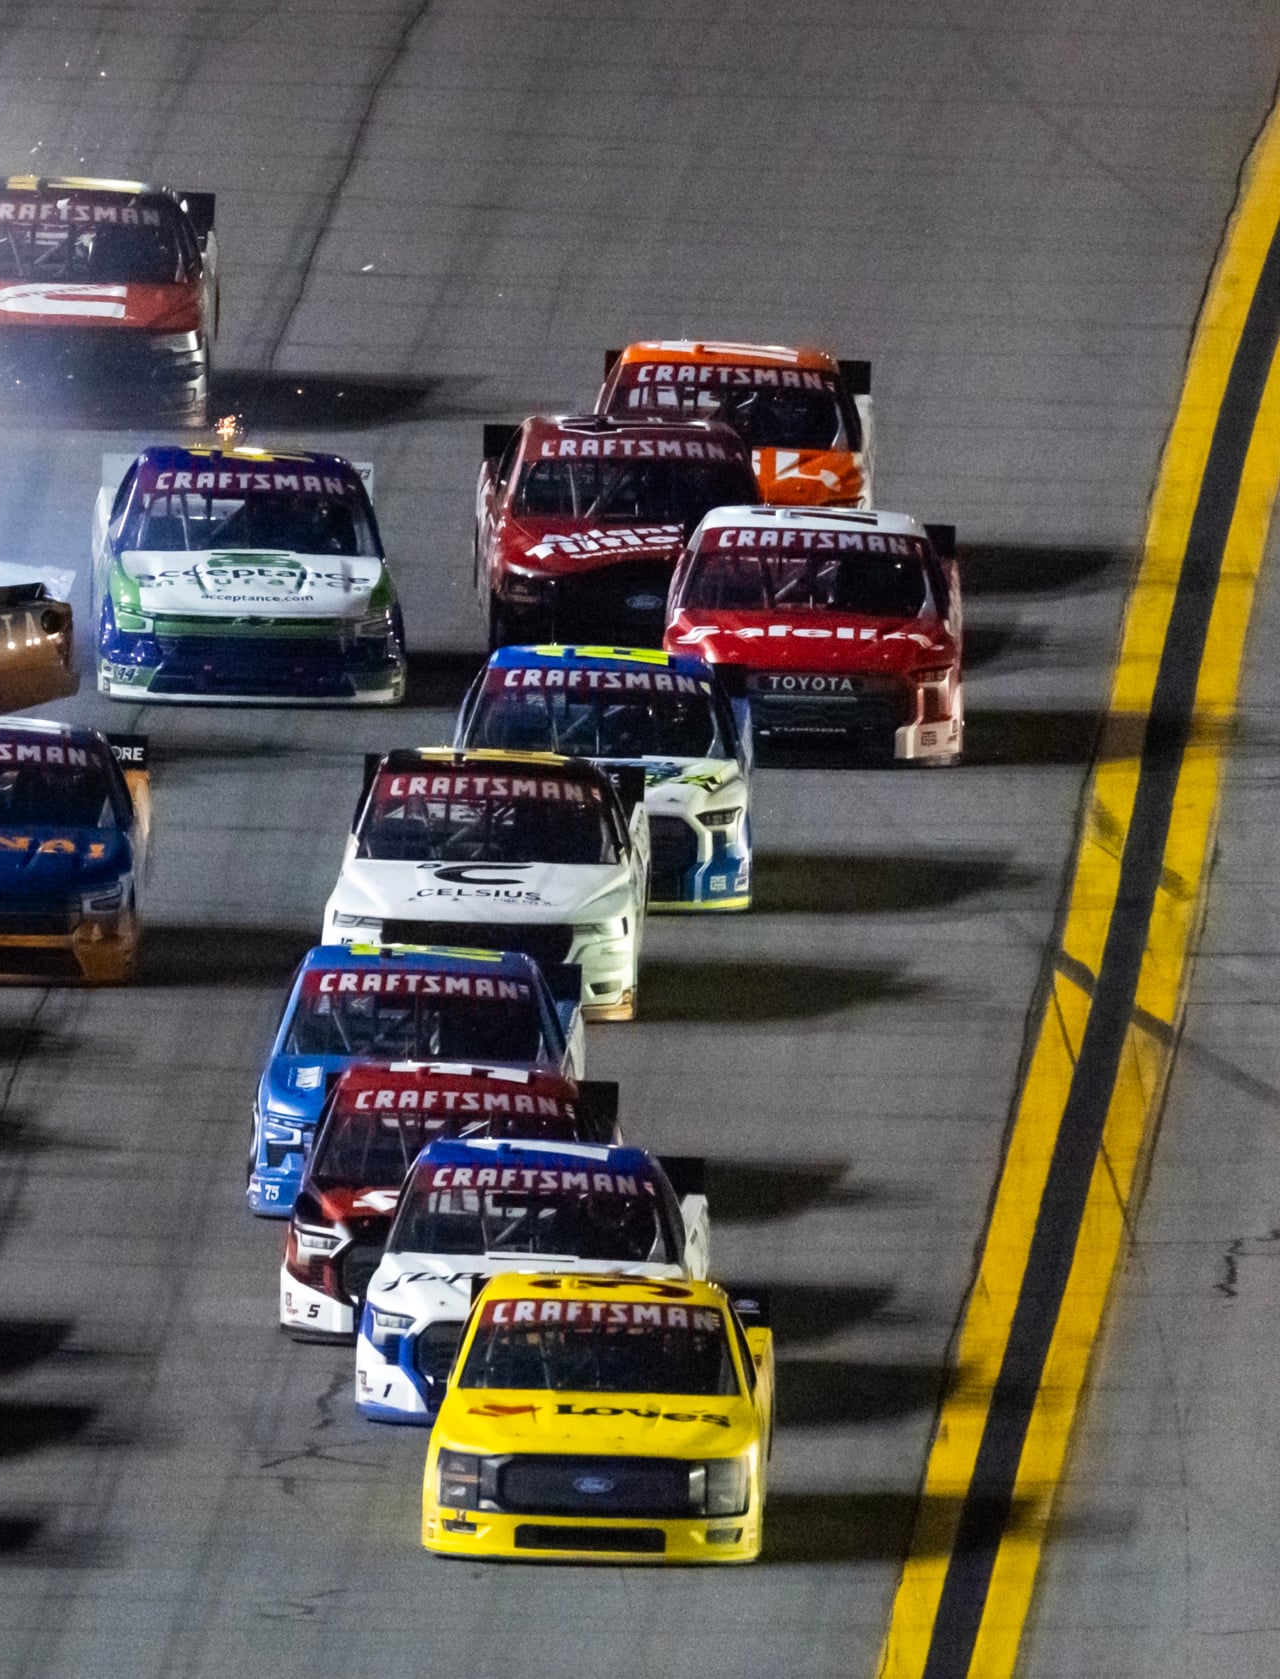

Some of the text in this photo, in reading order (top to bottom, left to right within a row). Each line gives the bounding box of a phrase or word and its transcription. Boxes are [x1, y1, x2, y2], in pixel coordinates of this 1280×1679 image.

[637, 365, 822, 389] CRAFTSMAN
[541, 438, 726, 460] CRAFTSMAN
[156, 472, 345, 495] CRAFTSMAN
[718, 529, 910, 555] CRAFTSMAN
[201, 594, 314, 602] acceptance.com
[504, 669, 698, 695] CRAFTSMAN
[769, 675, 854, 692] TOYOTA
[390, 777, 583, 801] CRAFTSMAN
[416, 888, 542, 901] CELSIUS
[320, 974, 520, 999] CRAFTSMAN
[355, 1090, 558, 1116] CRAFTSMAN
[264, 1184, 280, 1201] 75
[432, 1168, 638, 1195] CRAFTSMAN
[307, 1304, 321, 1318] 5
[493, 1300, 716, 1331] CRAFTSMAN
[382, 1383, 392, 1398] 1
